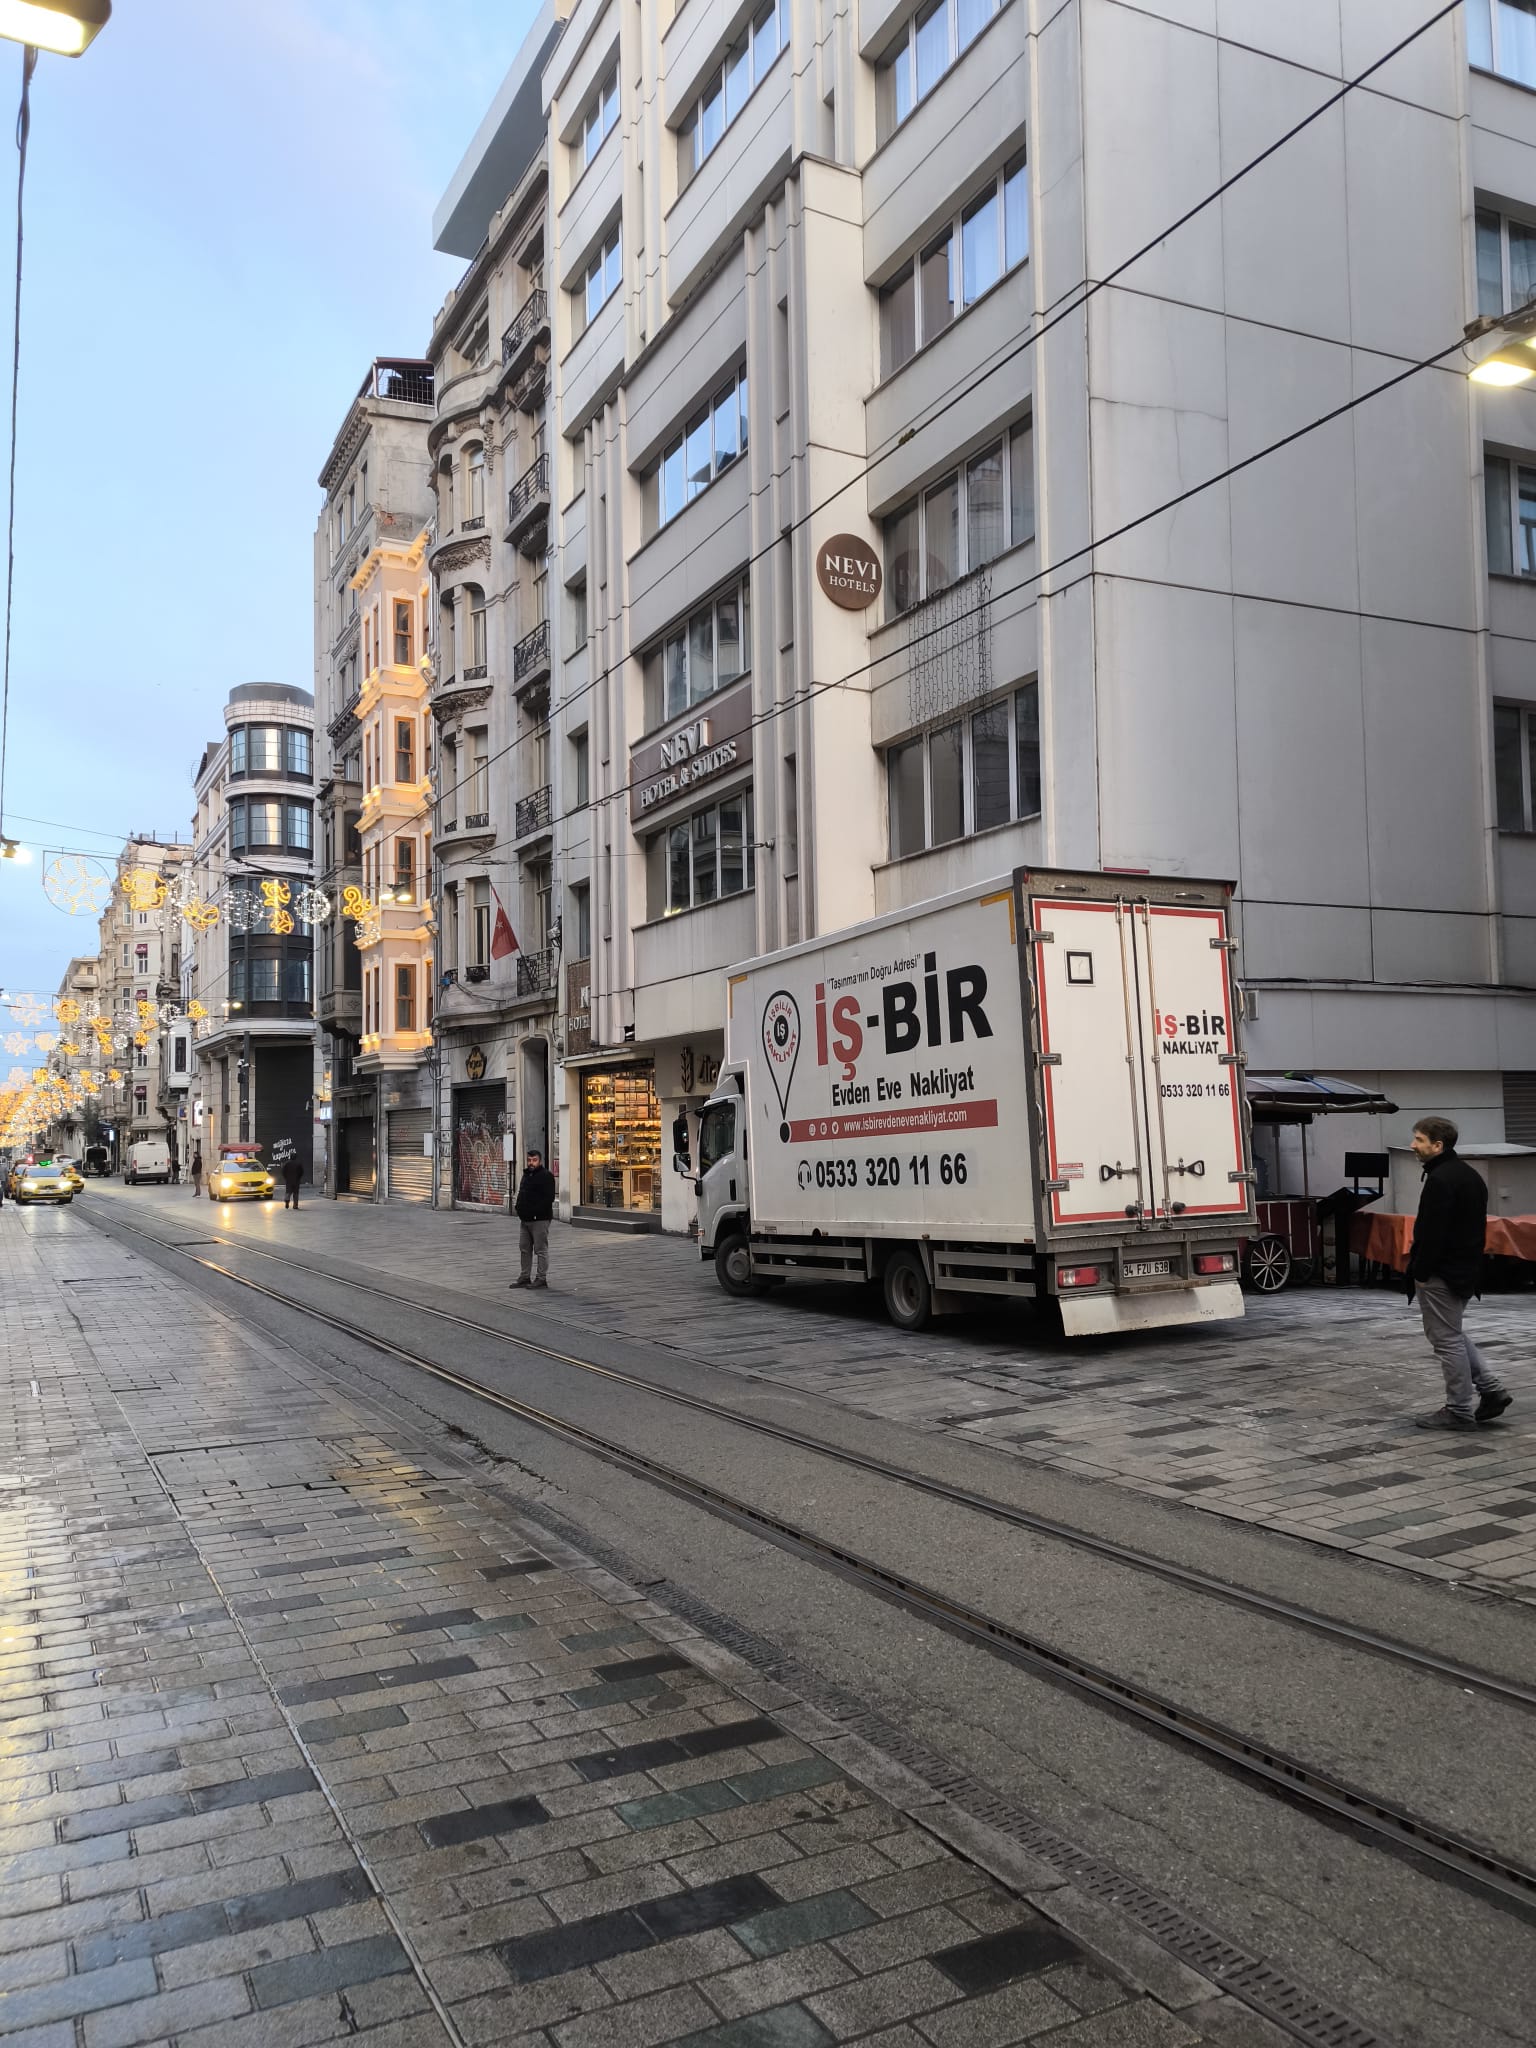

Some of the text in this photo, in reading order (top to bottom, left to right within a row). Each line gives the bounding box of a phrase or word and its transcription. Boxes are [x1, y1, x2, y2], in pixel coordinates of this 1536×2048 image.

[825, 553, 877, 580] NEVI
[829, 575, 875, 593] HOTELS
[661, 717, 712, 769] NEVI
[641, 741, 737, 808] HOTEL & SUITES
[870, 964, 892, 981] Doğru
[832, 1065, 975, 1107] Evden Eve Nakliyat
[1161, 1083, 1230, 1098] 0533 320 11 66
[843, 1109, 967, 1133] www.isbirevdenevenakliyat.com
[815, 1153, 968, 1188] 0533 320 11 66
[1123, 1264, 1134, 1276] 34
